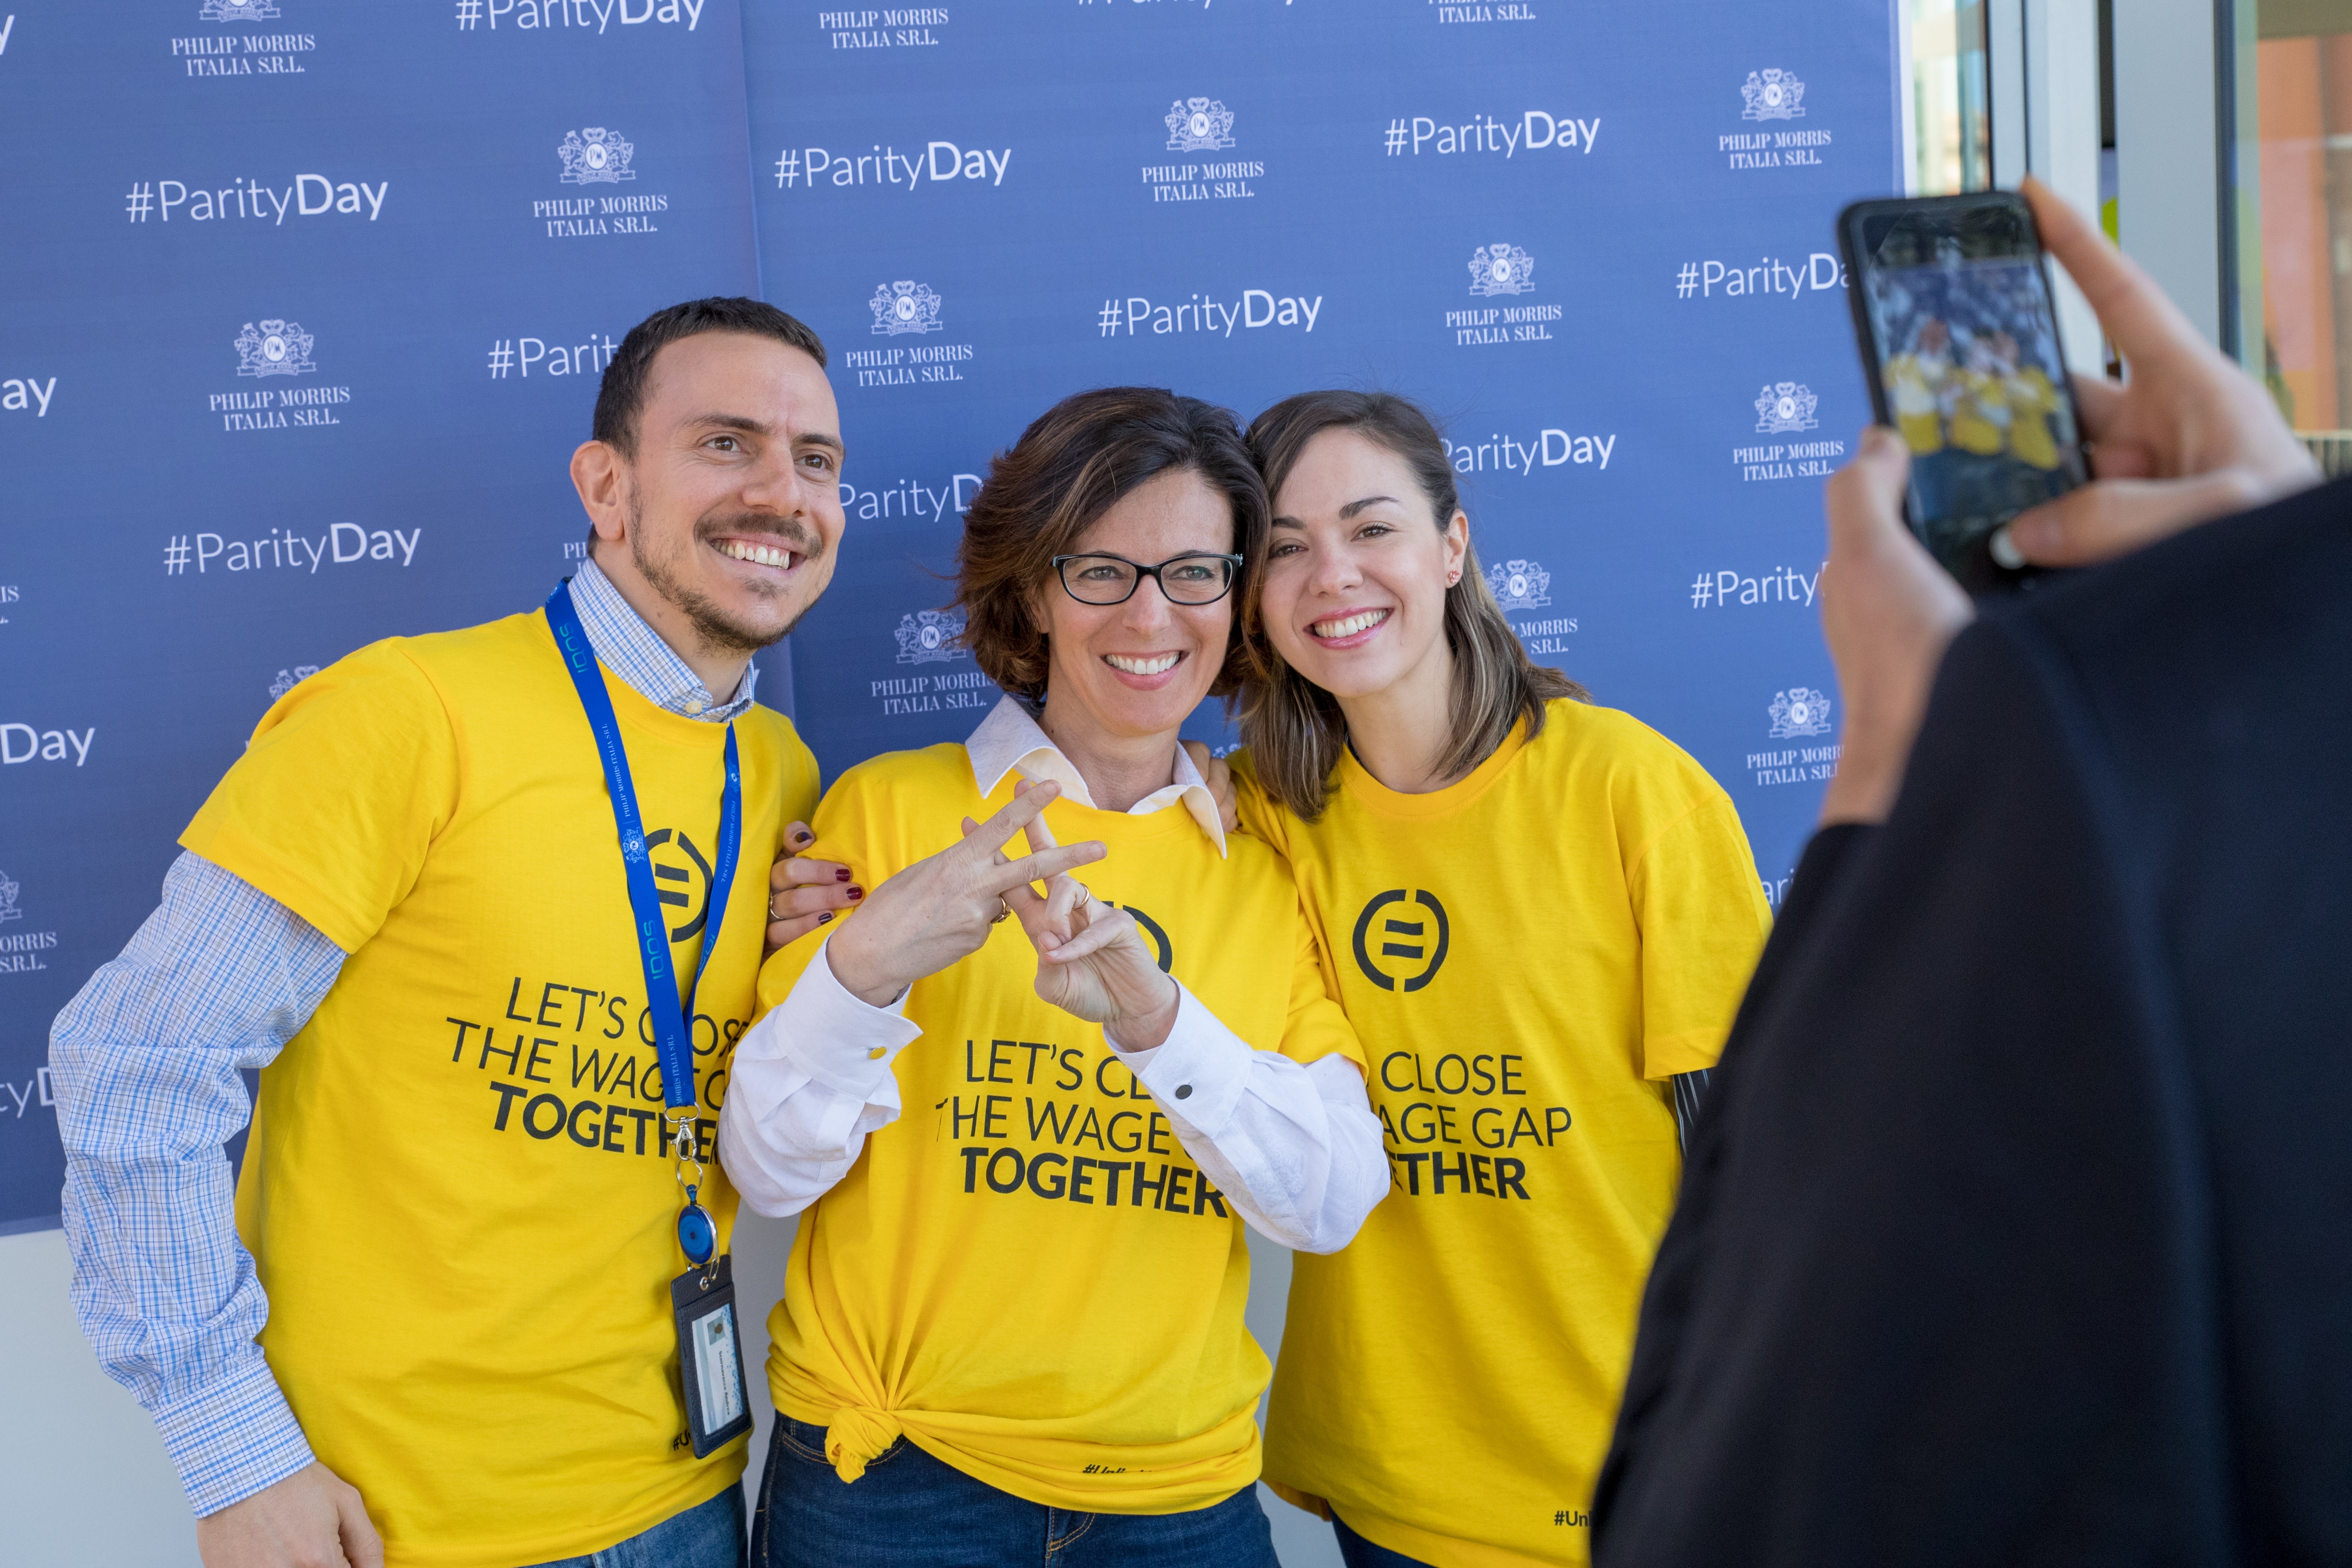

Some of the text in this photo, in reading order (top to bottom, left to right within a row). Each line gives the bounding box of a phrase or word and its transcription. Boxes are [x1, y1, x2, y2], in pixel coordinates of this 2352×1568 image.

[456, 0, 704, 34] #ParityDay
[820, 8, 948, 28] PHILIP MORRIS
[1439, 4, 1536, 23] ITALIA S.R.L.
[172, 34, 316, 55] PHILIP MORRIS
[833, 29, 938, 48] ITALIA S.R.L.
[187, 56, 305, 76] ITALIA S.R.L.
[1385, 111, 1600, 158] #ParityDay
[1719, 130, 1831, 151] PHILIP MORRIS
[775, 142, 1011, 190] #ParityDay
[1730, 149, 1822, 169] ITALIA S.R.L.
[1143, 162, 1264, 183] PHILIP MORRIS
[126, 174, 388, 225] #ParityDay
[1154, 182, 1255, 202] ITALIA S.R.L.
[534, 195, 668, 217] PHILIP MORRIS
[548, 216, 658, 237] ITALIA S.R.L.
[1676, 253, 1849, 300] #ParityD
[1098, 290, 1322, 338] #ParityDay
[1446, 305, 1562, 327] PHILIP MORRIS
[1457, 325, 1552, 345] ITALIA S.R.L.
[488, 334, 618, 379] #Parit
[847, 345, 973, 368] PHILIP MORRIS
[859, 365, 963, 387] ITALIA S.R.L.
[210, 387, 350, 411] PHILIP MORRIS
[224, 408, 340, 431] ITALIA S.R.L.
[1441, 429, 1616, 476] arityDay
[1733, 441, 1844, 464] PHILIP MORRIS
[1744, 460, 1834, 481] ITALIA S.R.L.
[839, 474, 984, 523] ParityD
[164, 523, 421, 575] #ParityDay
[1691, 566, 1819, 609] #Parity
[1520, 618, 1578, 637] MORRIS
[1531, 638, 1568, 654] S.R.L.
[872, 678, 928, 697] PHILIP
[884, 692, 987, 715] ITALIA S.R.L.
[607, 741, 618, 764] ITALIA
[1747, 750, 1797, 769] PHILIP
[614, 765, 624, 792] MORRIS
[1757, 768, 1807, 786] ITALIA
[620, 793, 630, 817] PHILIP
[0, 932, 57, 953] ORRIS
[506, 977, 627, 1039] LET'S
[446, 1017, 558, 1084] THE
[572, 1044, 700, 1103] WAG
[672, 1053, 680, 1077] ITALIA
[967, 1040, 1084, 1091] LET'S
[1381, 1051, 1526, 1096] CLOSE
[1025, 1096, 1171, 1156] WAGE
[1378, 1102, 1572, 1148] AGE GAP
[960, 1147, 1228, 1219] TOGETHER
